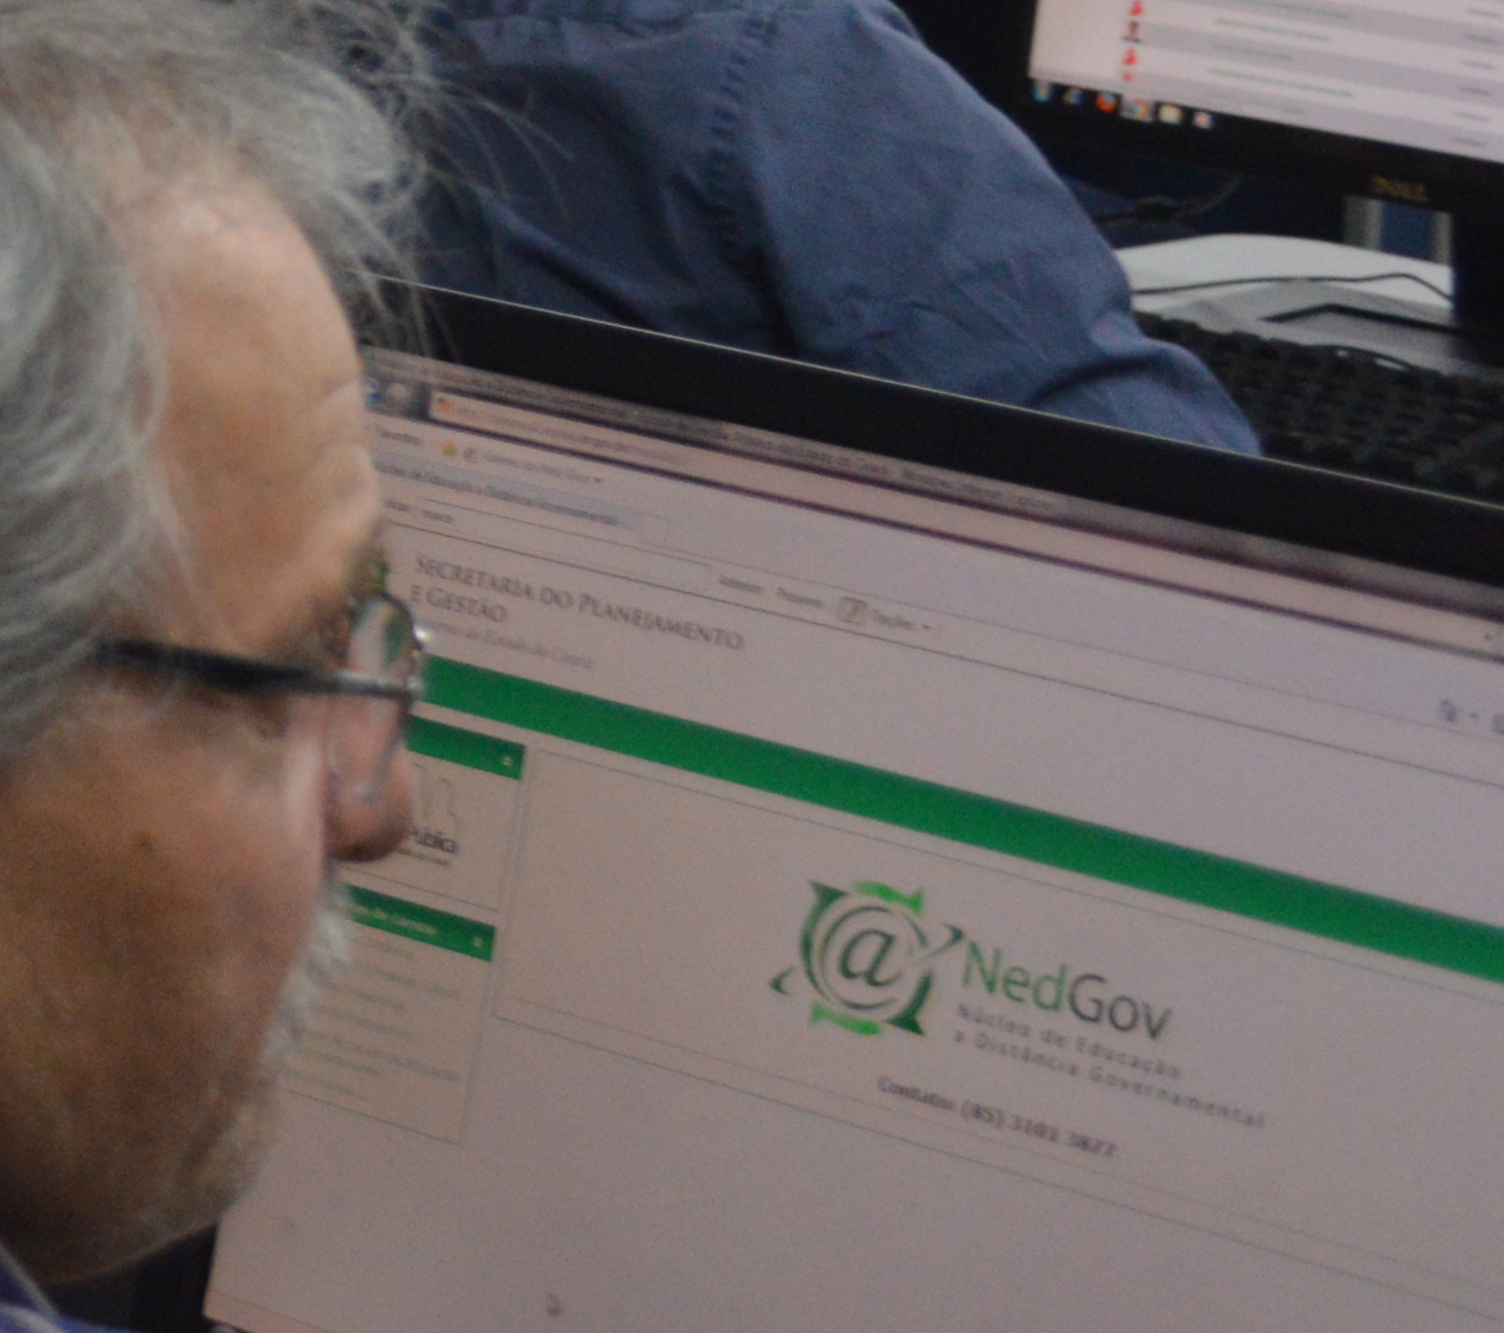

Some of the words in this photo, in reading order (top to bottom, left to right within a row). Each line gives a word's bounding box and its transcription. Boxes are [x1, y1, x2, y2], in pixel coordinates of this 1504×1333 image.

[413, 554, 536, 602] SECRETARIA
[577, 593, 746, 651] PLANEJAMENTO
[961, 939, 1174, 1040] NedGov
[956, 1003, 1032, 1038] Núcleo
[1075, 1036, 1181, 1080] Educação
[1090, 1065, 1268, 1129] Governamental
